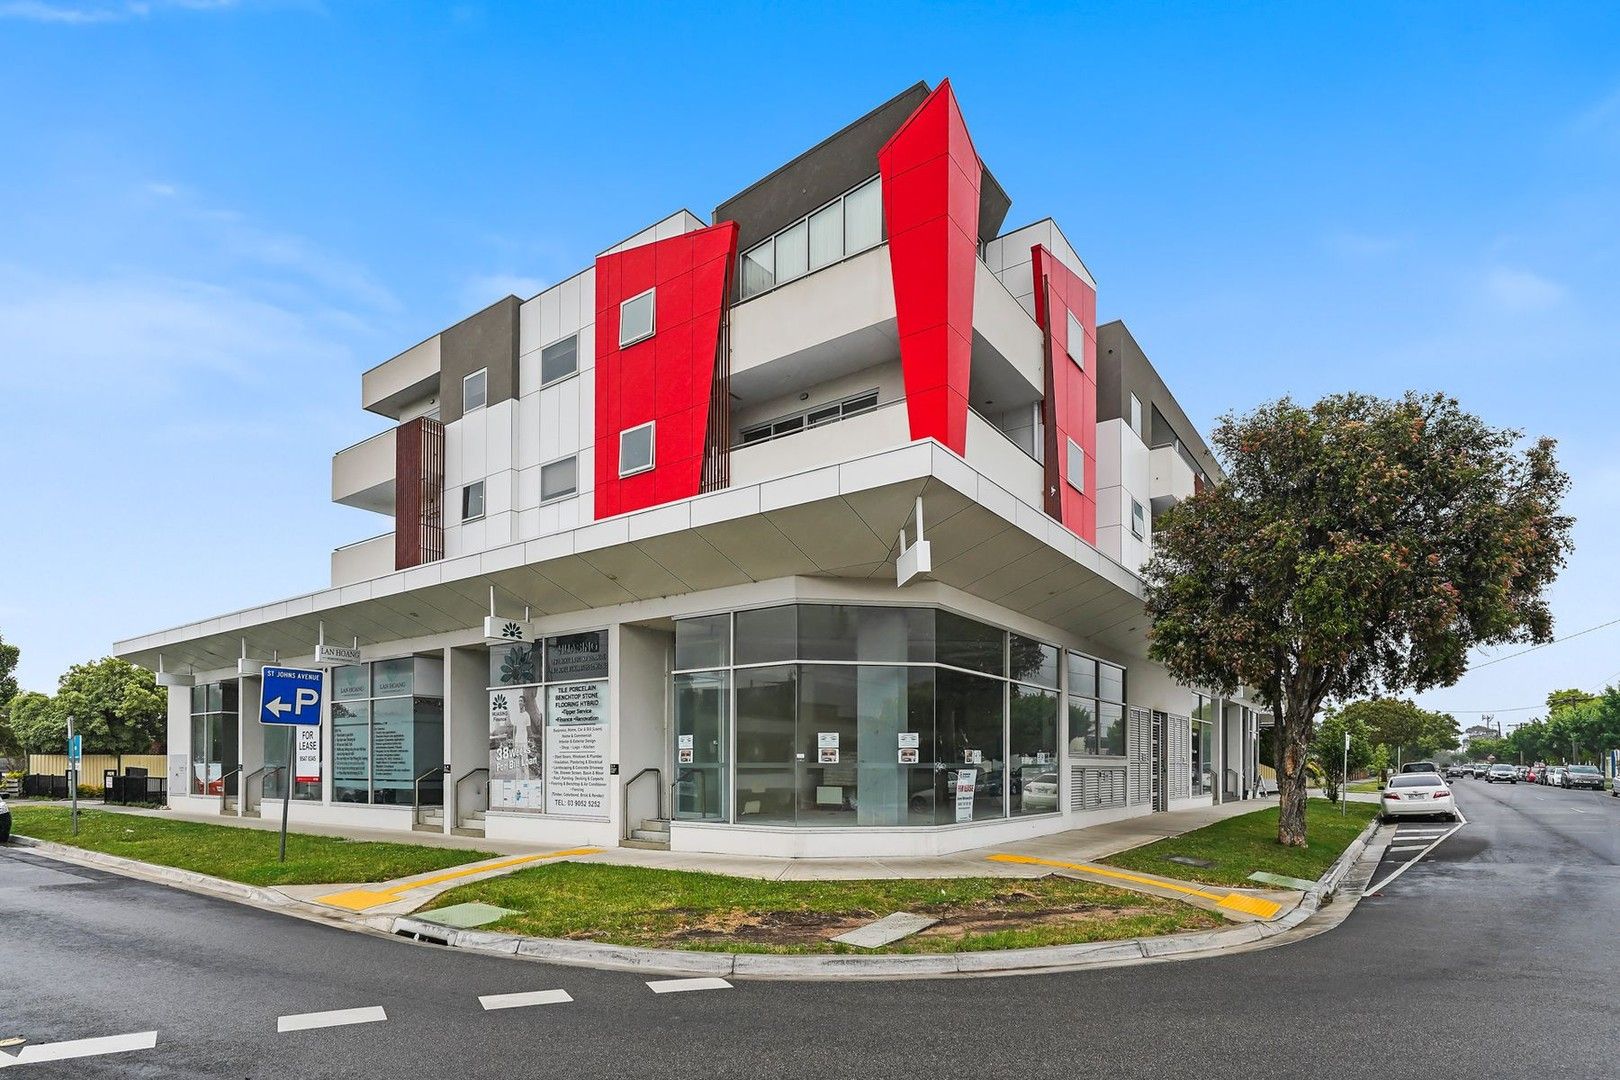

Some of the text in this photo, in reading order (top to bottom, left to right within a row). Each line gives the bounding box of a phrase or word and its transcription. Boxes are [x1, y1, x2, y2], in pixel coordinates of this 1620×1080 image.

[336, 649, 360, 658] HOANG
[297, 673, 320, 681] AVENUE
[295, 688, 319, 715] P
[302, 730, 314, 740] FOR
[299, 742, 317, 751] LEASE
[496, 746, 508, 760] 38
